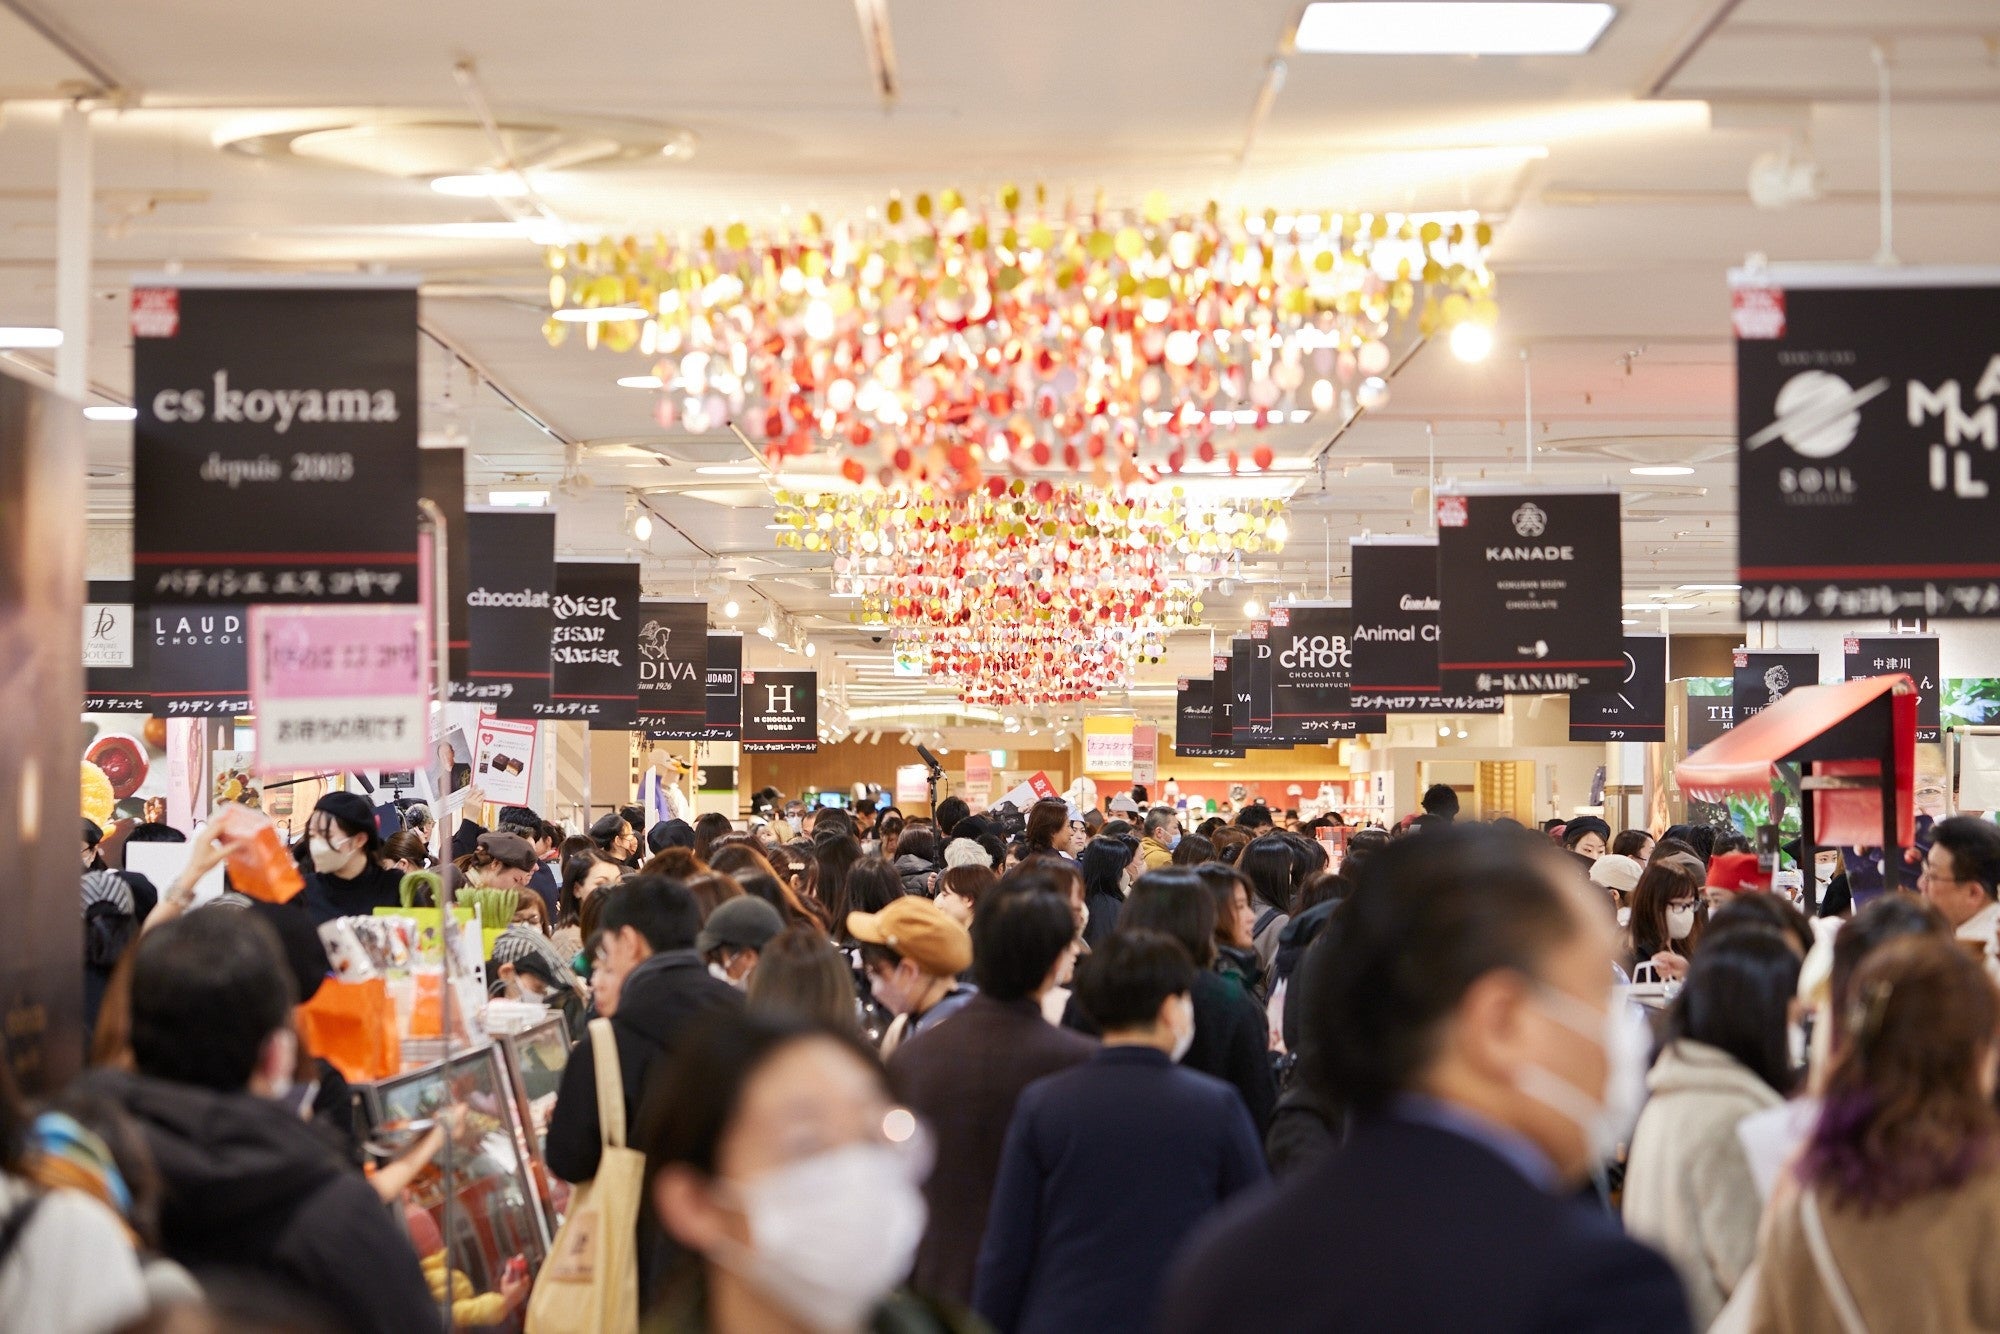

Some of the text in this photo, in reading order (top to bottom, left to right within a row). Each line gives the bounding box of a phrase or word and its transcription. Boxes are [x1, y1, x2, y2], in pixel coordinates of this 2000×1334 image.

[213, 368, 400, 434] koyama
[1485, 546, 1575, 561] KANADE
[272, 570, 325, 597] エス
[328, 568, 402, 597] コヤマ
[466, 587, 550, 608] chocolat
[156, 616, 240, 634] LAUD
[1353, 624, 1415, 642] Animal
[156, 635, 244, 646] CHOCOL
[1257, 644, 1272, 659] D
[1873, 657, 1911, 670] 中津川
[640, 661, 698, 681] DIVA
[1289, 671, 1342, 679] CHOCOLATE
[655, 681, 673, 691] 1926
[764, 684, 795, 713] H
[1237, 693, 1251, 702] VA
[1350, 695, 1504, 709] ゴンチャロフ アニマルショコラ
[168, 700, 215, 713] ラウデン
[1222, 703, 1233, 716] T
[1707, 706, 1733, 719] TH
[1301, 720, 1356, 731] コウベ チョコ
[1610, 730, 1625, 738] ラウ
[743, 743, 817, 751] アッシュ チョコレートワールド
[1186, 748, 1237, 756] ミッシェル・ブラン
